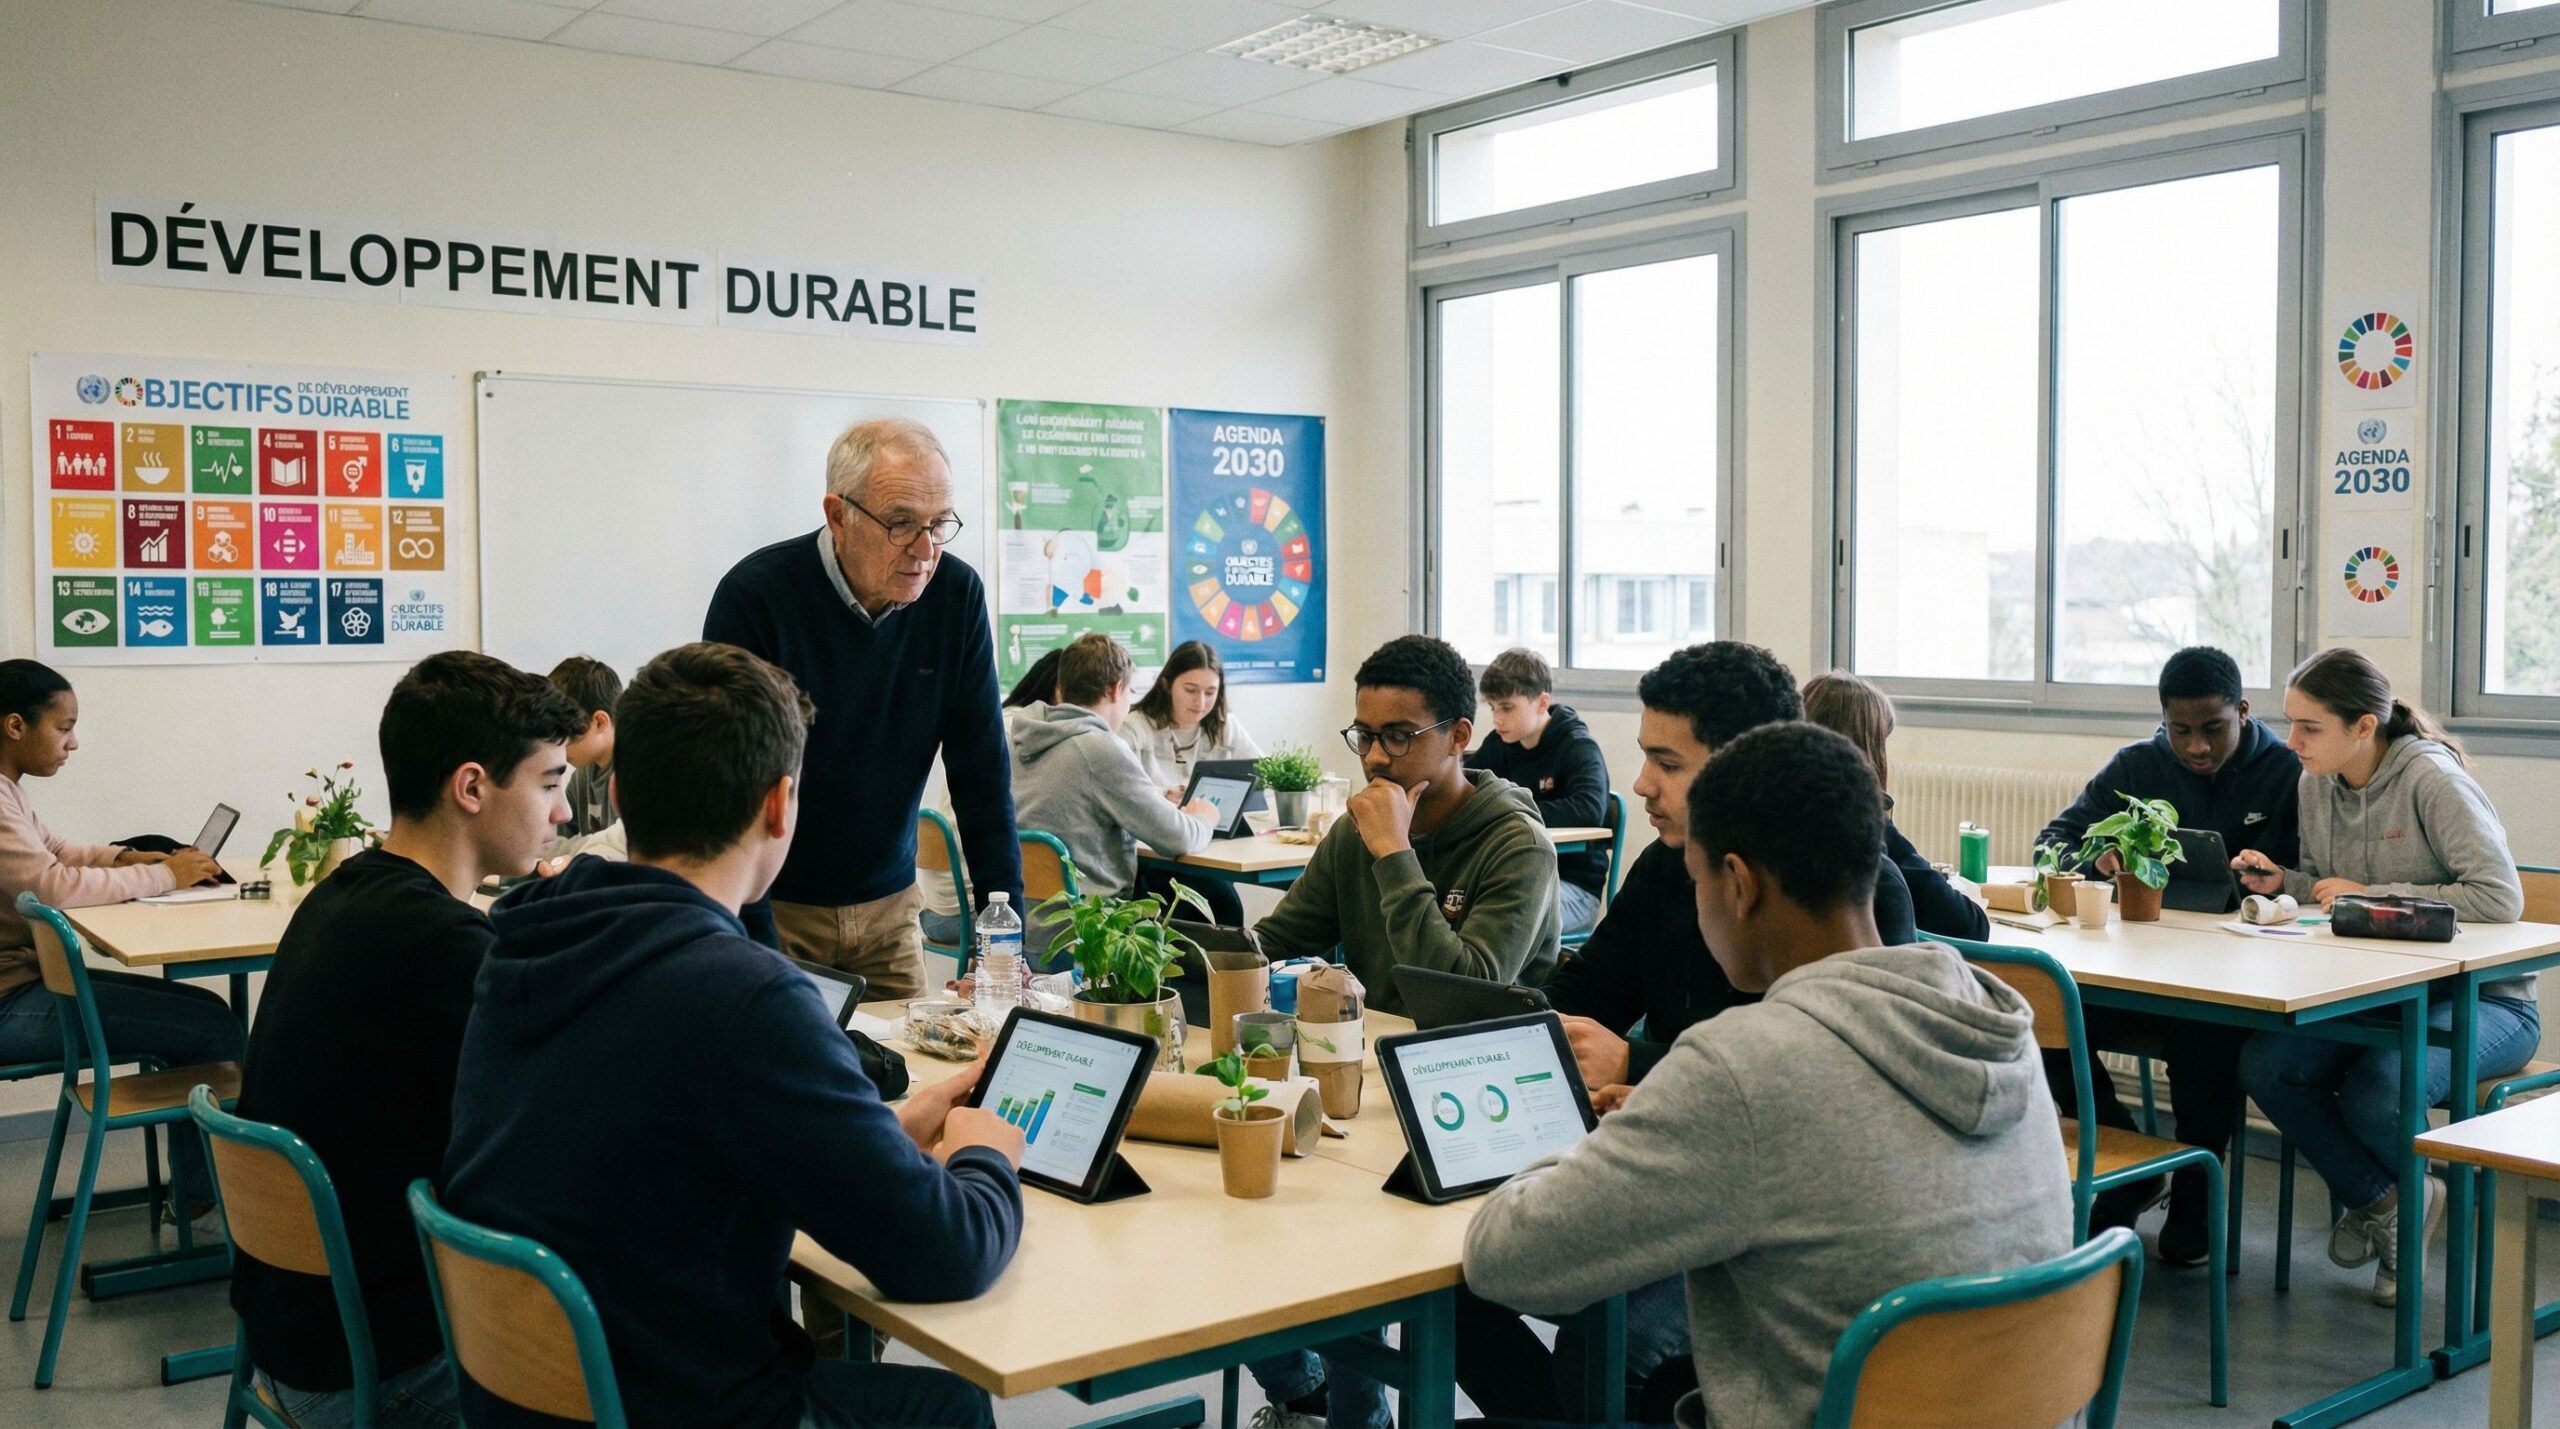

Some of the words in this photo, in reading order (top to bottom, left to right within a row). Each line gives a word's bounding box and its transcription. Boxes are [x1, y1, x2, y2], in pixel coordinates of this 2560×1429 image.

[111, 201, 699, 310] DÉVELOPPEMENT
[726, 267, 977, 333] DURABLE
[299, 395, 410, 420] DURABLE
[55, 425, 62, 439] 1
[126, 427, 134, 443] 2
[195, 430, 203, 446] 3
[1212, 424, 1284, 446] AGENDA
[263, 433, 271, 448] 4
[391, 438, 399, 453] 6
[1212, 446, 1285, 478] 2030
[2335, 448, 2410, 466] AGENDA
[2334, 466, 2410, 494] 2030
[57, 503, 65, 518] 7
[128, 504, 136, 519] 8
[263, 507, 276, 522] 10
[57, 581, 71, 597] 13
[128, 581, 141, 597] 14
[331, 582, 342, 597] 17
[391, 620, 444, 631] DURABLE
